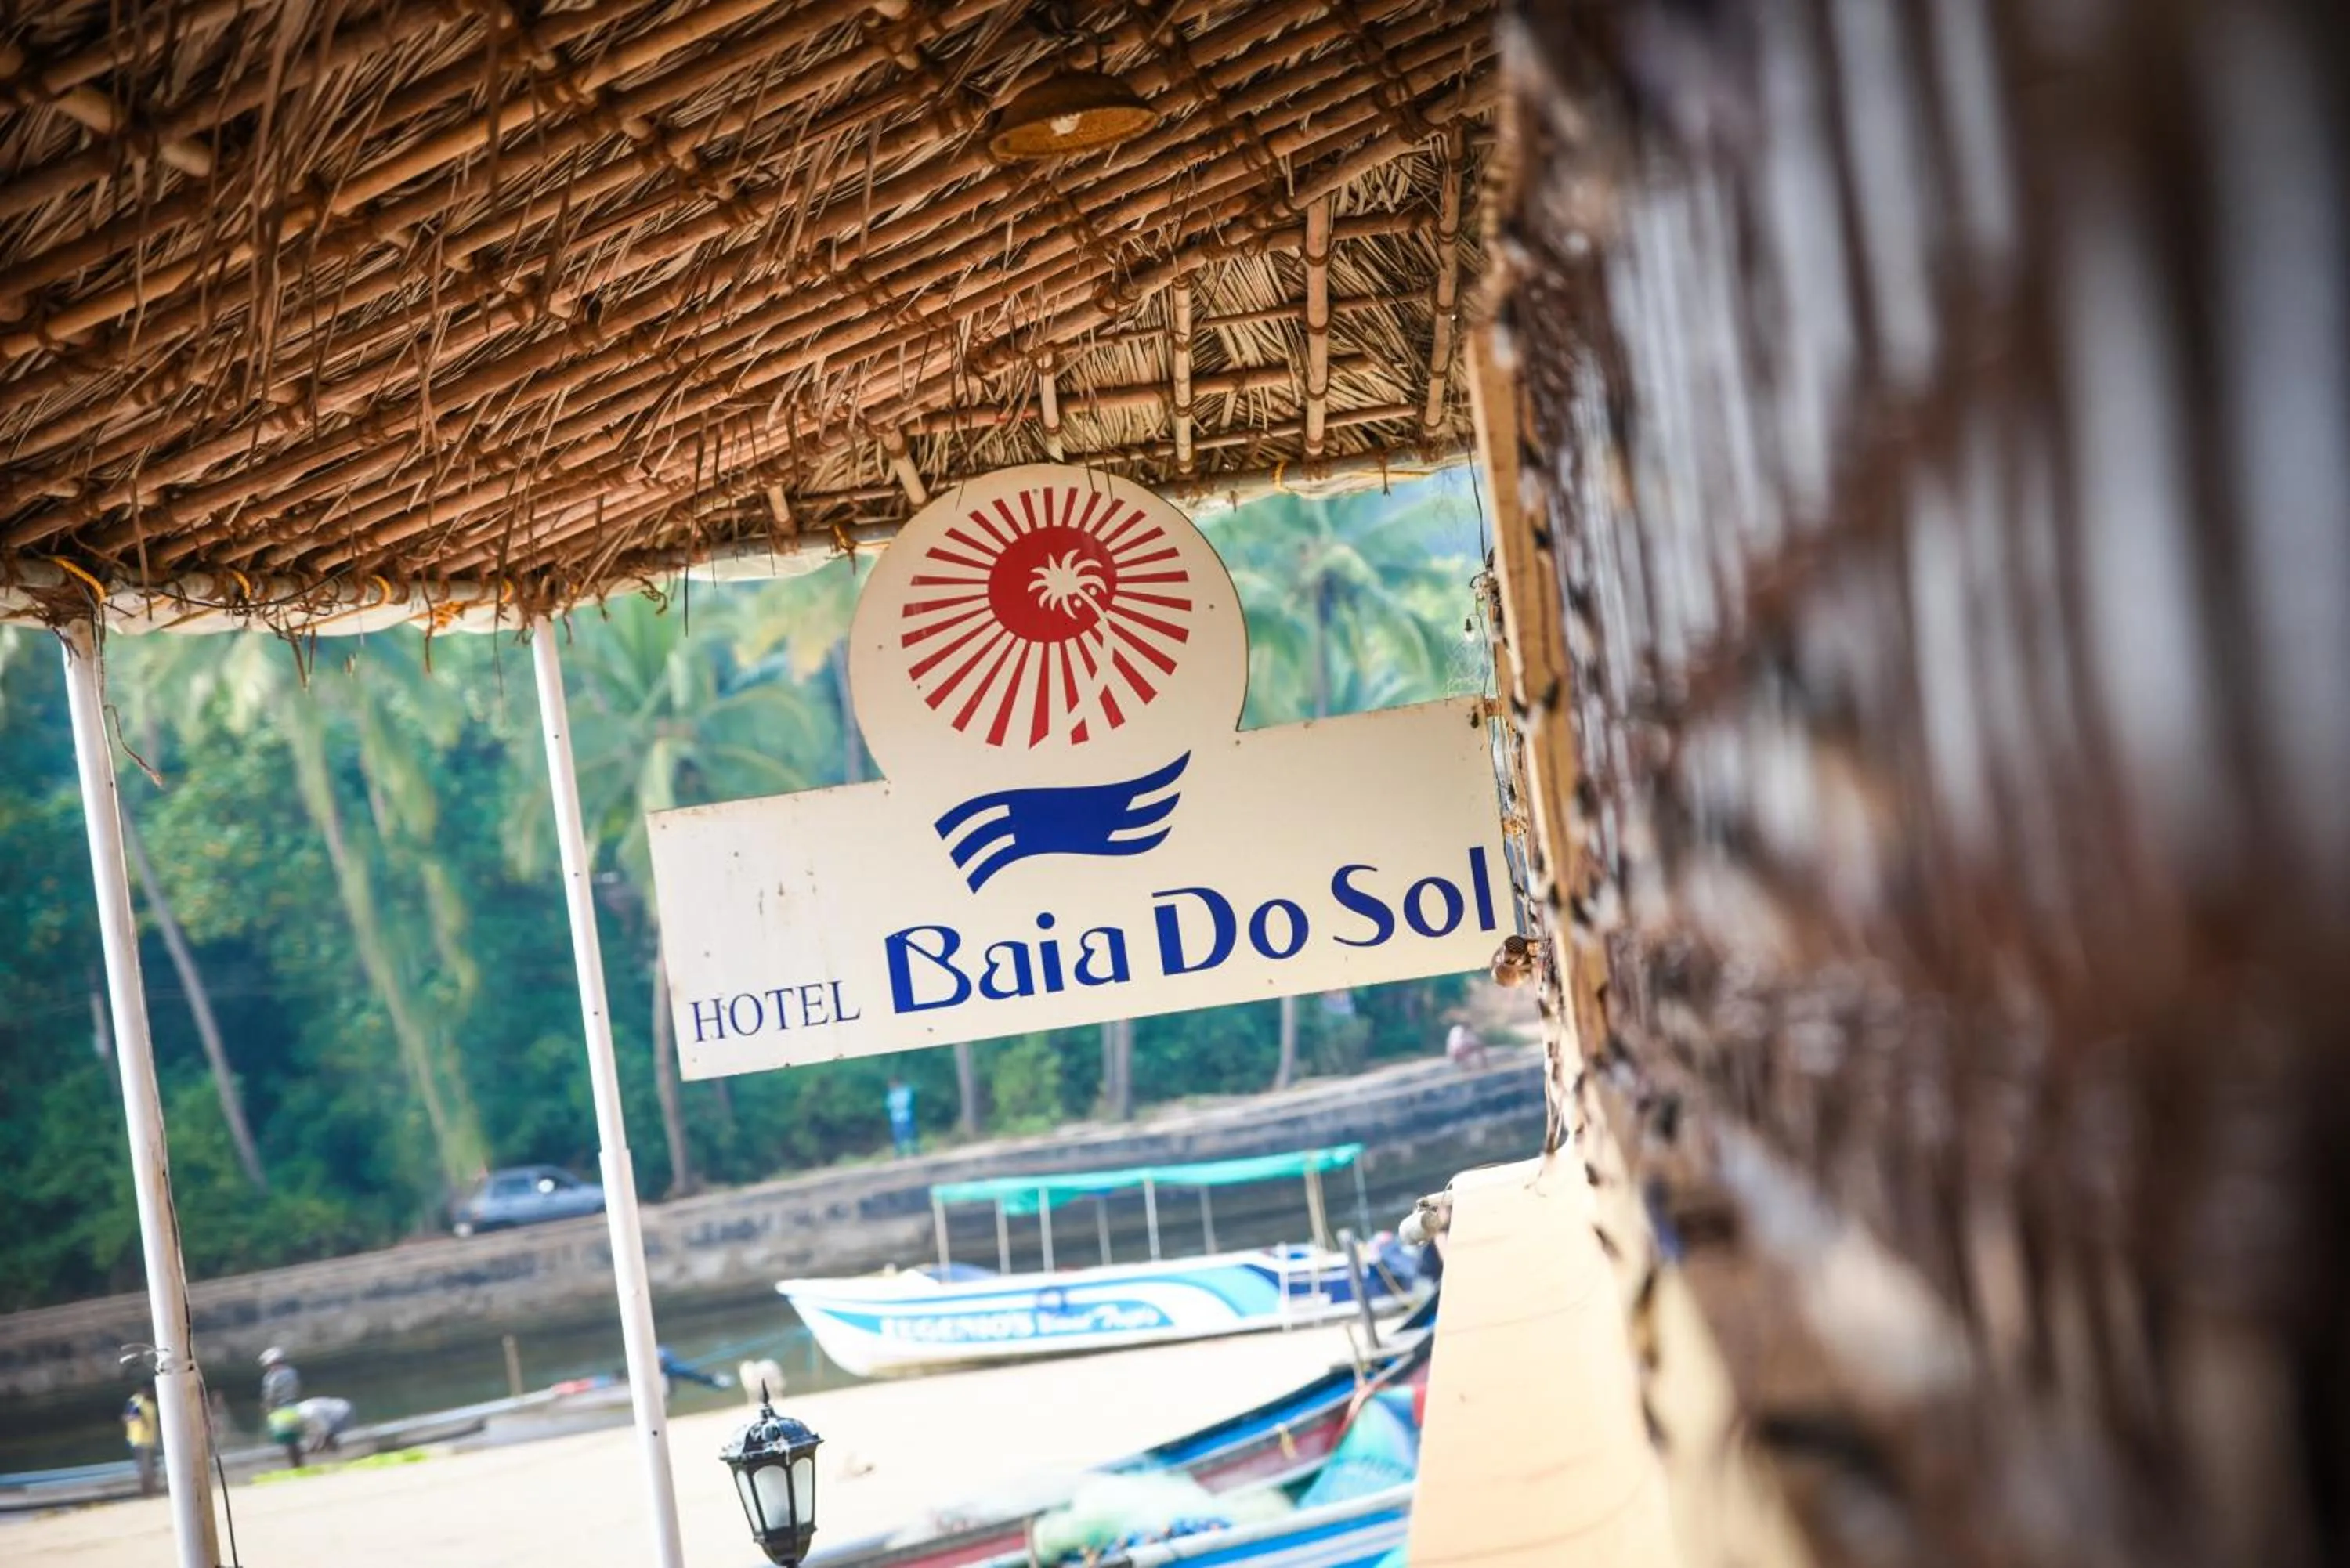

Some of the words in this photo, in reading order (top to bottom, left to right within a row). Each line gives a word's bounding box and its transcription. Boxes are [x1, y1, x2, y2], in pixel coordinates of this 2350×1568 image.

[689, 980, 861, 1042] HOTEL
[884, 911, 1130, 1016] Baia
[1152, 887, 1311, 977] Do
[1332, 847, 1495, 946] Sol
